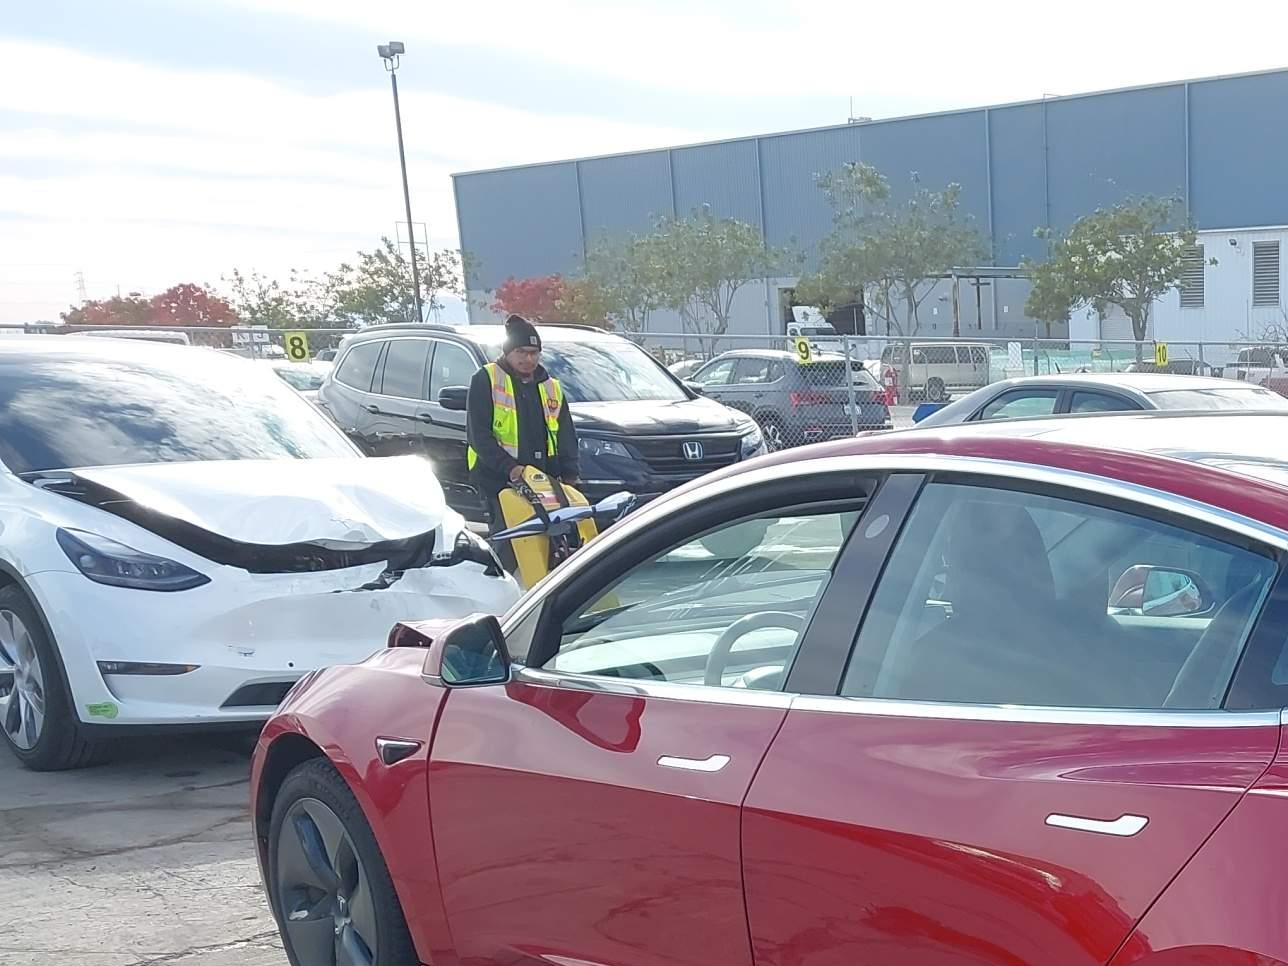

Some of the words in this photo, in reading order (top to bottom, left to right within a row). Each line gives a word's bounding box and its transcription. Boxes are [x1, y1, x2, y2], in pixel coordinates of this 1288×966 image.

[289, 336, 306, 360] 8
[798, 341, 809, 360] 9
[1157, 345, 1167, 363] 10
